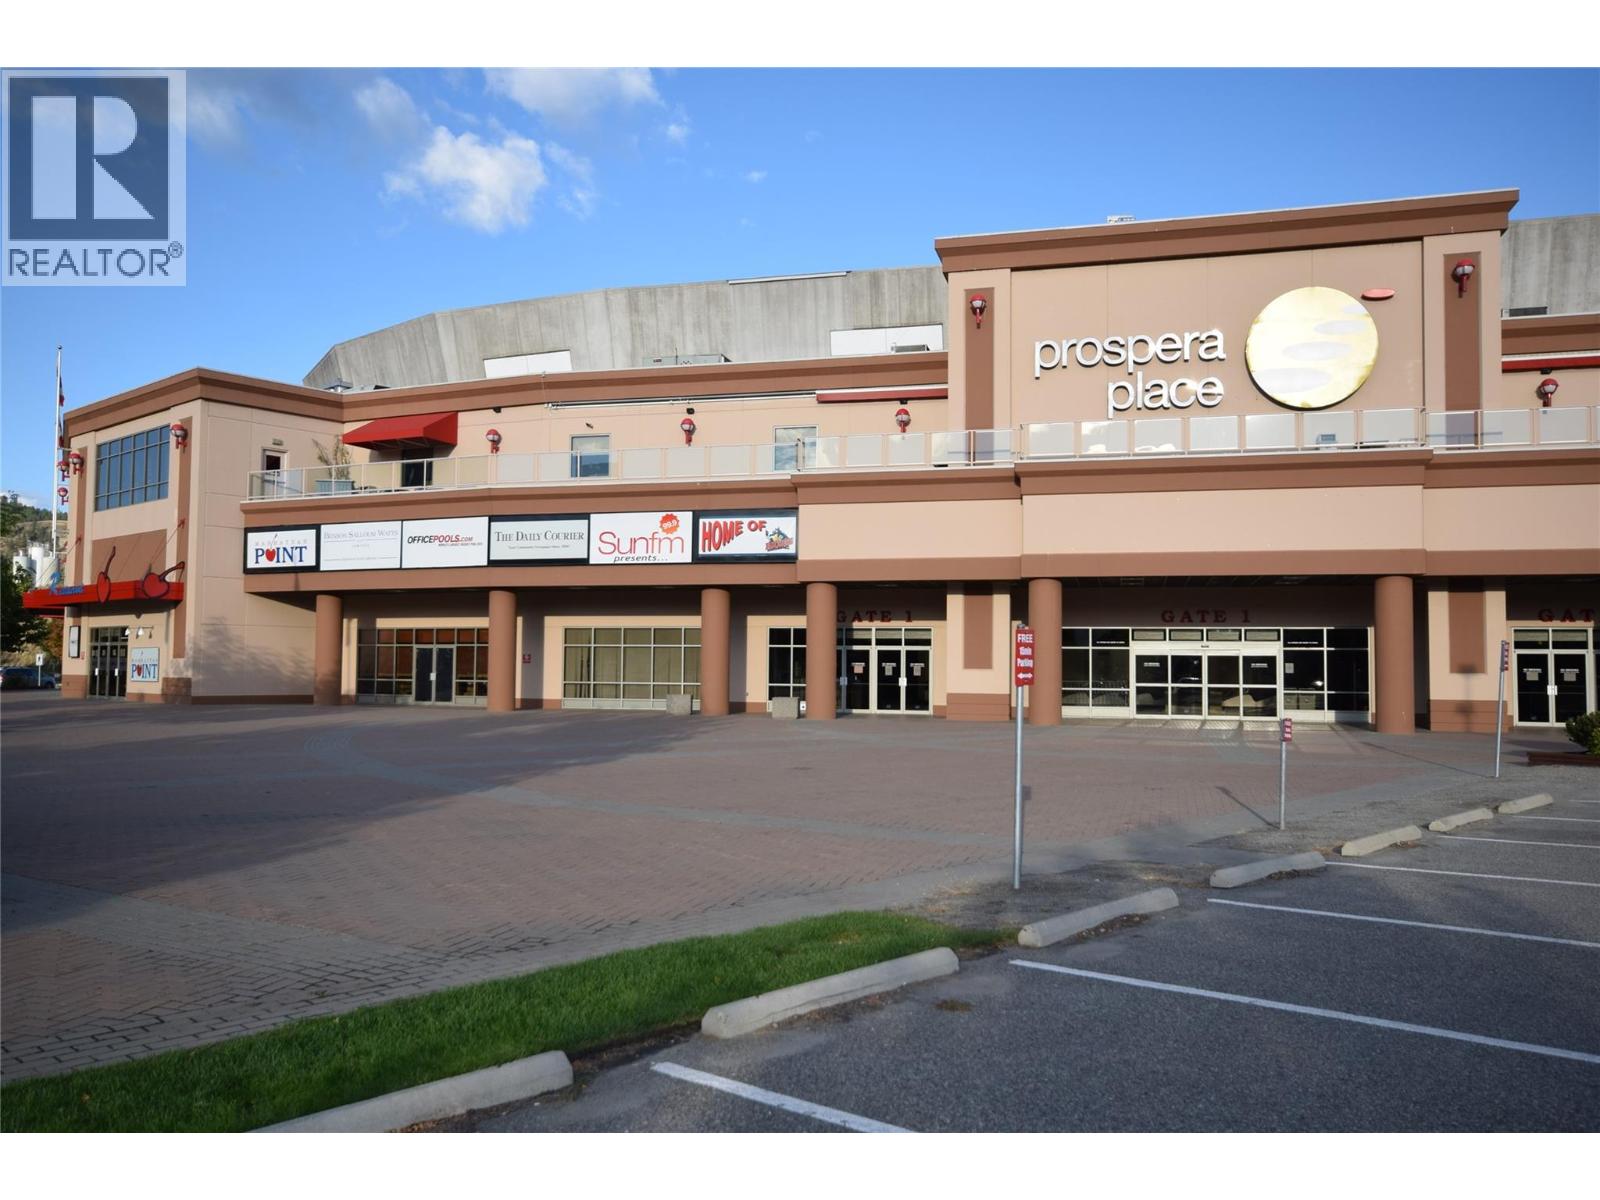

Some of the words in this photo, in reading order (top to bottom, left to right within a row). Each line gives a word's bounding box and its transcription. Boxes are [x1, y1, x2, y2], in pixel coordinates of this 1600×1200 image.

[1034, 328, 1226, 378] prospera
[1107, 371, 1224, 418] place
[495, 532, 513, 542] THE
[516, 531, 541, 541] DAILY
[544, 530, 584, 540] COURIER
[702, 521, 743, 552] HOME
[747, 520, 767, 532] OF
[836, 610, 892, 622] GATE
[905, 610, 913, 622] 1
[1161, 610, 1227, 623] GATE
[1241, 610, 1251, 623] 1
[1017, 633, 1033, 643] FREE
